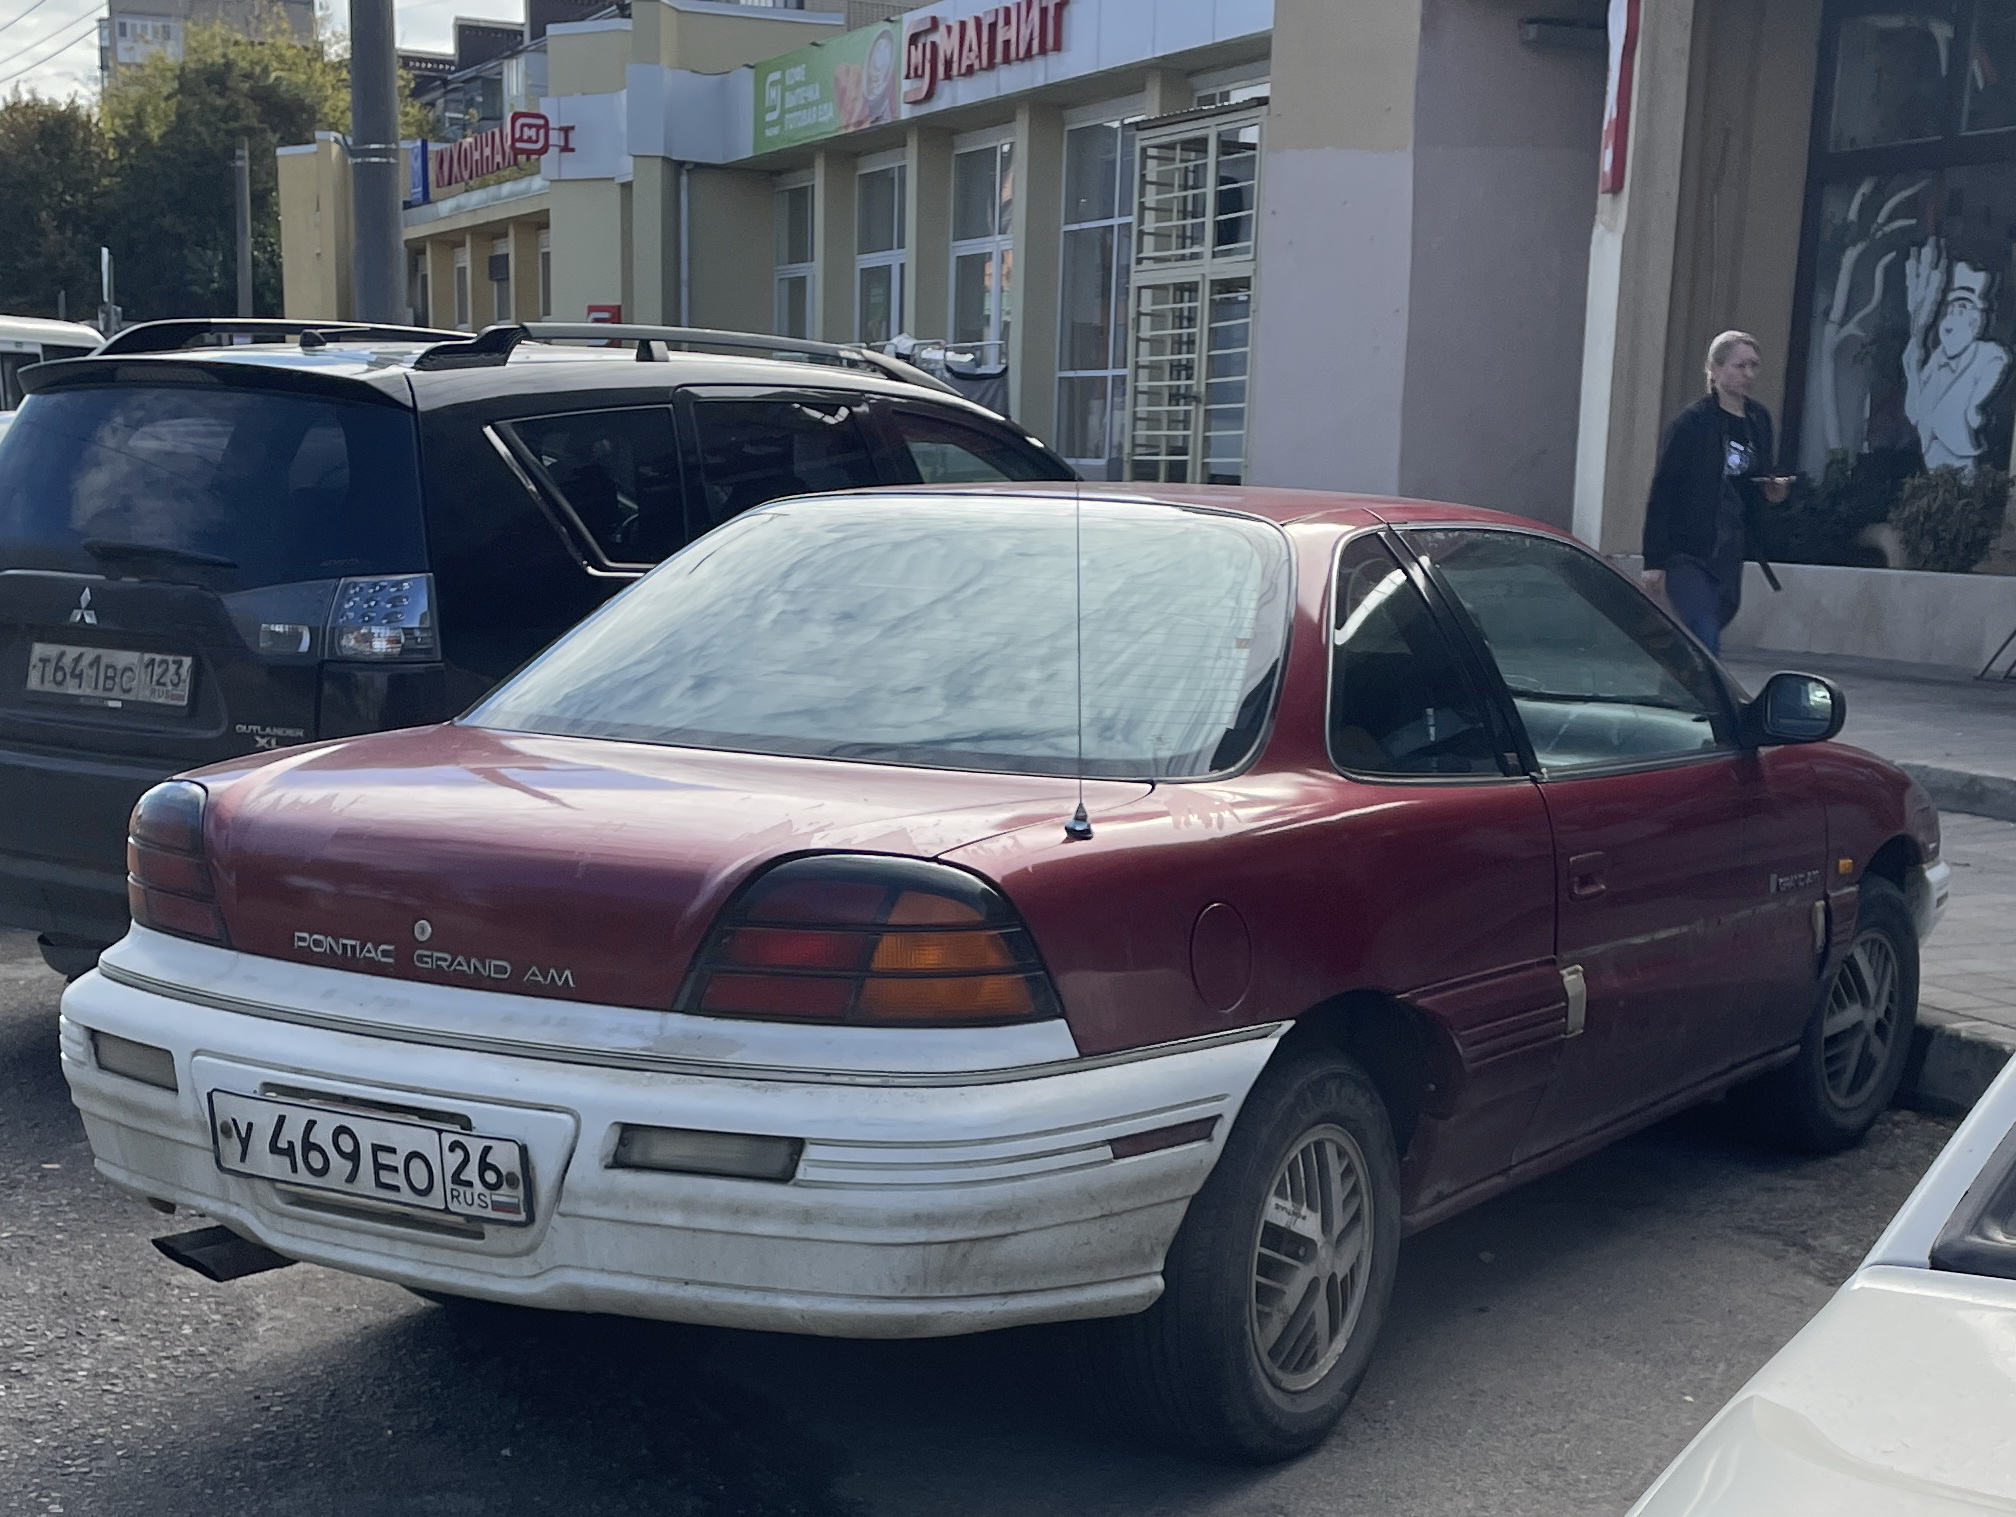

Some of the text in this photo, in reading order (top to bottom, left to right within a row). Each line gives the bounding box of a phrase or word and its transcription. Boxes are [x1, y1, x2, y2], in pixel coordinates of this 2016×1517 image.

[938, 0, 1070, 80] МАГНИТ
[38, 650, 183, 694] Т641ВС 123
[151, 687, 170, 699] RUS
[235, 723, 305, 737] OUTLANDER
[294, 931, 576, 988] PONTIAC GRAND AM
[448, 1139, 505, 1192] 26
[450, 1187, 489, 1211] RUS
